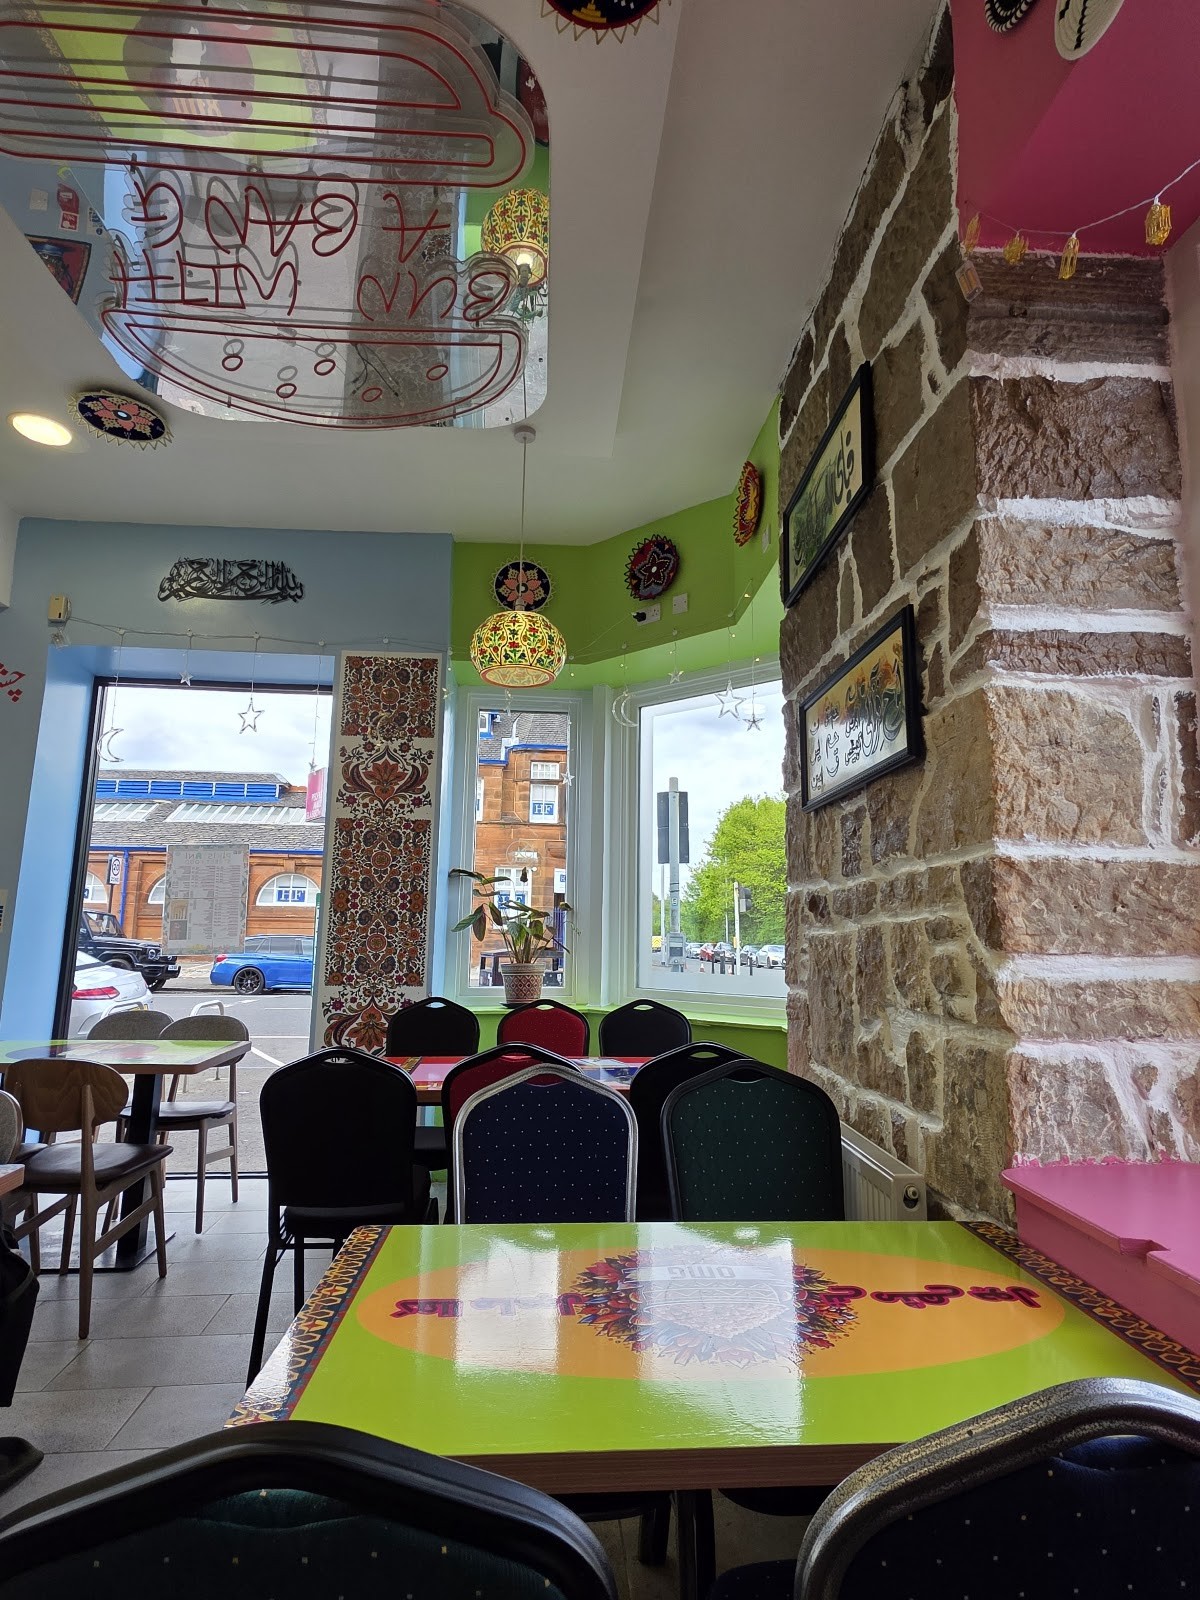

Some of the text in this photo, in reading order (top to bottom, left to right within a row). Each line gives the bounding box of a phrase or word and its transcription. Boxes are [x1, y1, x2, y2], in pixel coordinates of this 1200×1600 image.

[131, 180, 451, 263] A BANG
[109, 249, 510, 322] BUN WITH
[533, 803, 553, 815] HF
[279, 889, 303, 901] HF
